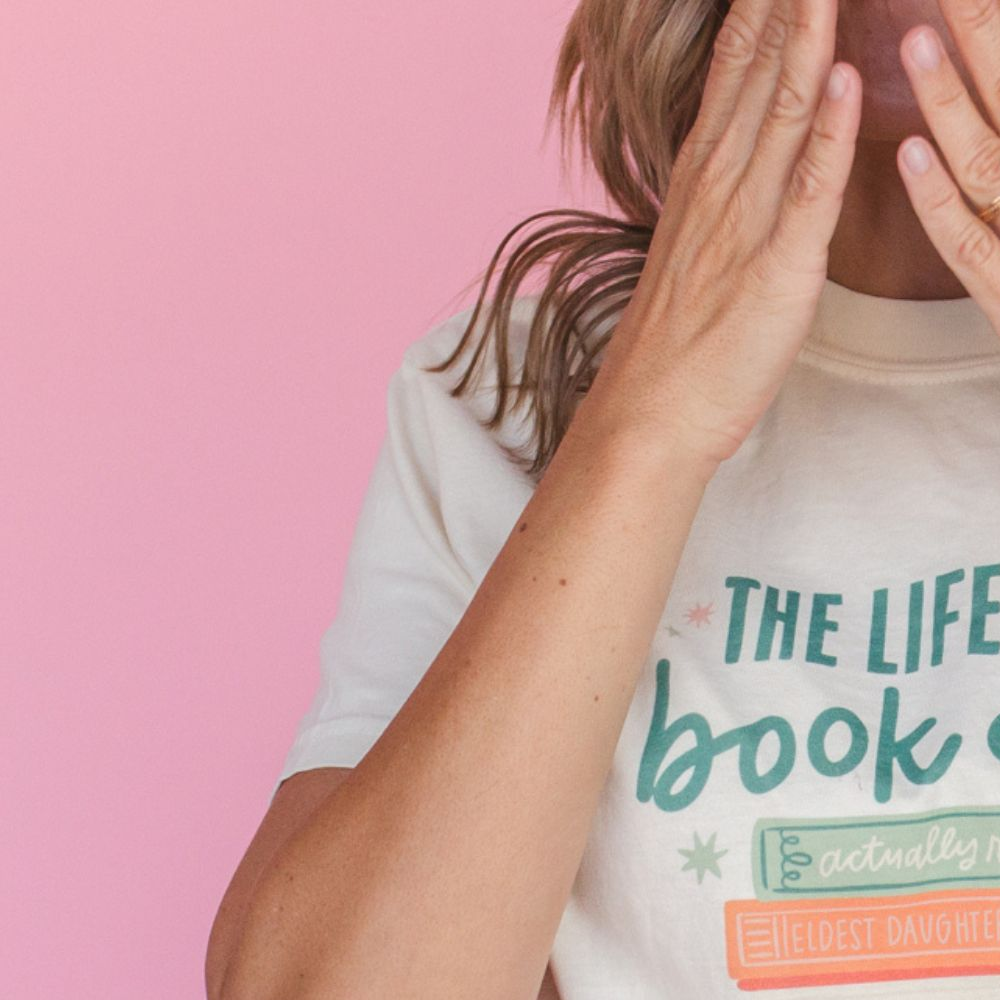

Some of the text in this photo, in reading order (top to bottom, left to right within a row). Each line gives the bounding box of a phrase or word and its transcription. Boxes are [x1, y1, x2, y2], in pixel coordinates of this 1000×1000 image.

[724, 576, 842, 667] THE
[636, 659, 962, 811] book
[819, 825, 978, 877] actually
[791, 917, 875, 953] ELDEST
